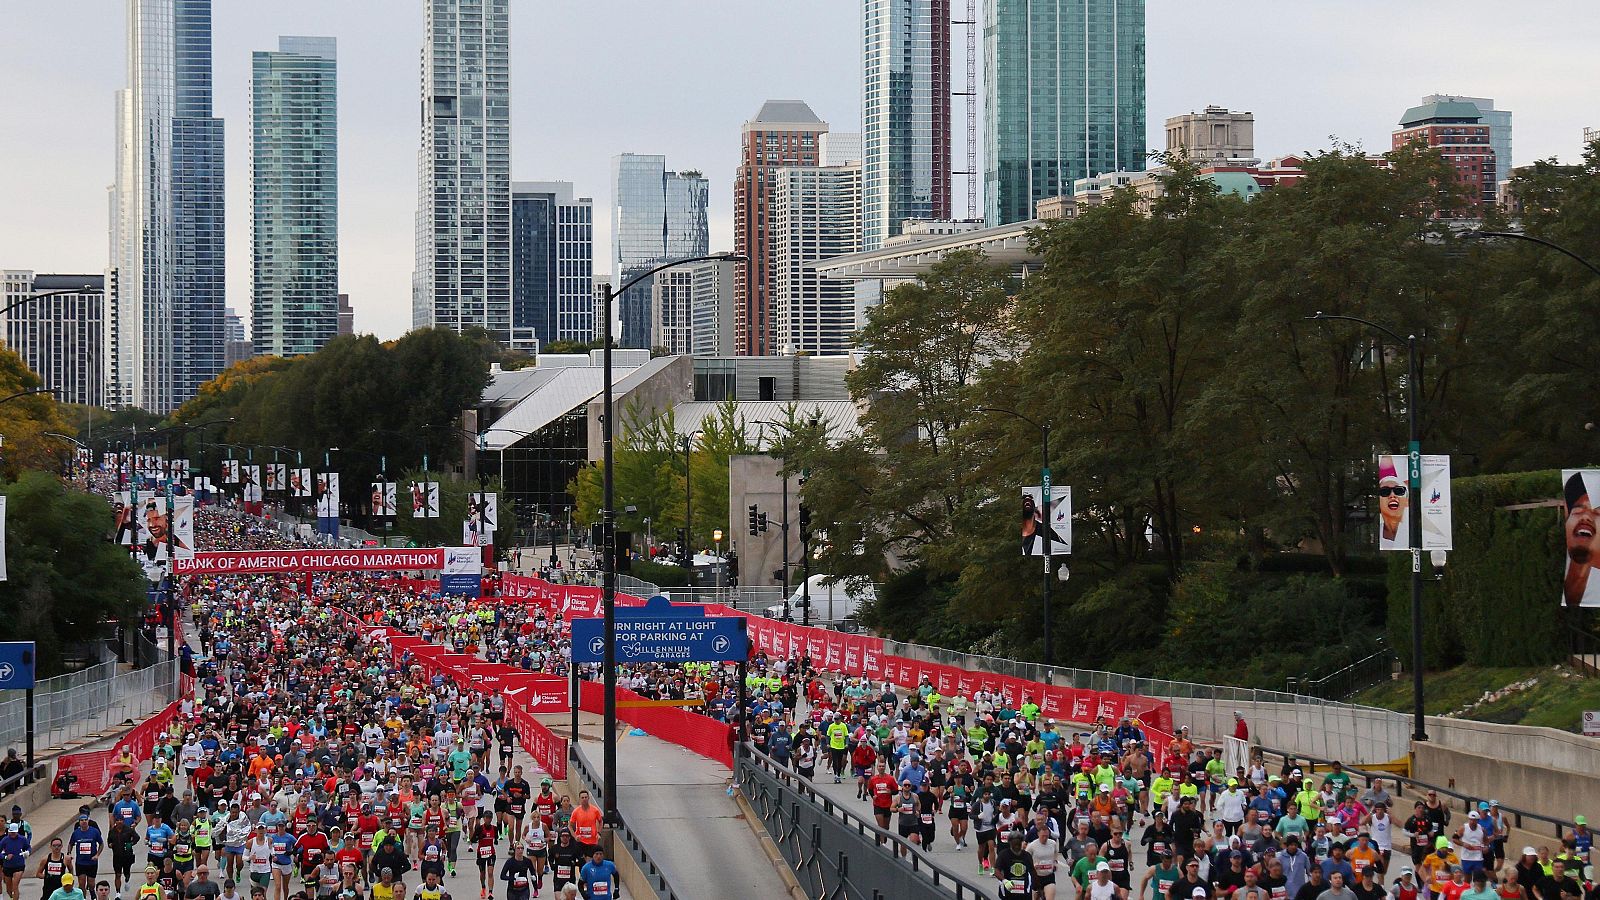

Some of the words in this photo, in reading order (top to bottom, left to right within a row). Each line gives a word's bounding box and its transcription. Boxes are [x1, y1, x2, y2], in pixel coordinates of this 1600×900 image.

[1410, 451, 1419, 478] C10
[177, 557, 214, 570] BANK
[217, 556, 236, 569] OF
[238, 553, 298, 568] AMERICA
[301, 554, 360, 567] CHICAGO
[363, 553, 438, 567] MARATHON
[634, 622, 666, 631] RIGHT
[668, 622, 682, 630] AT
[685, 621, 717, 630] LIGHT
[615, 633, 637, 641] FOR
[640, 633, 687, 641] PARKING
[689, 632, 704, 641] AT
[635, 645, 690, 653] MILLENNIUM
